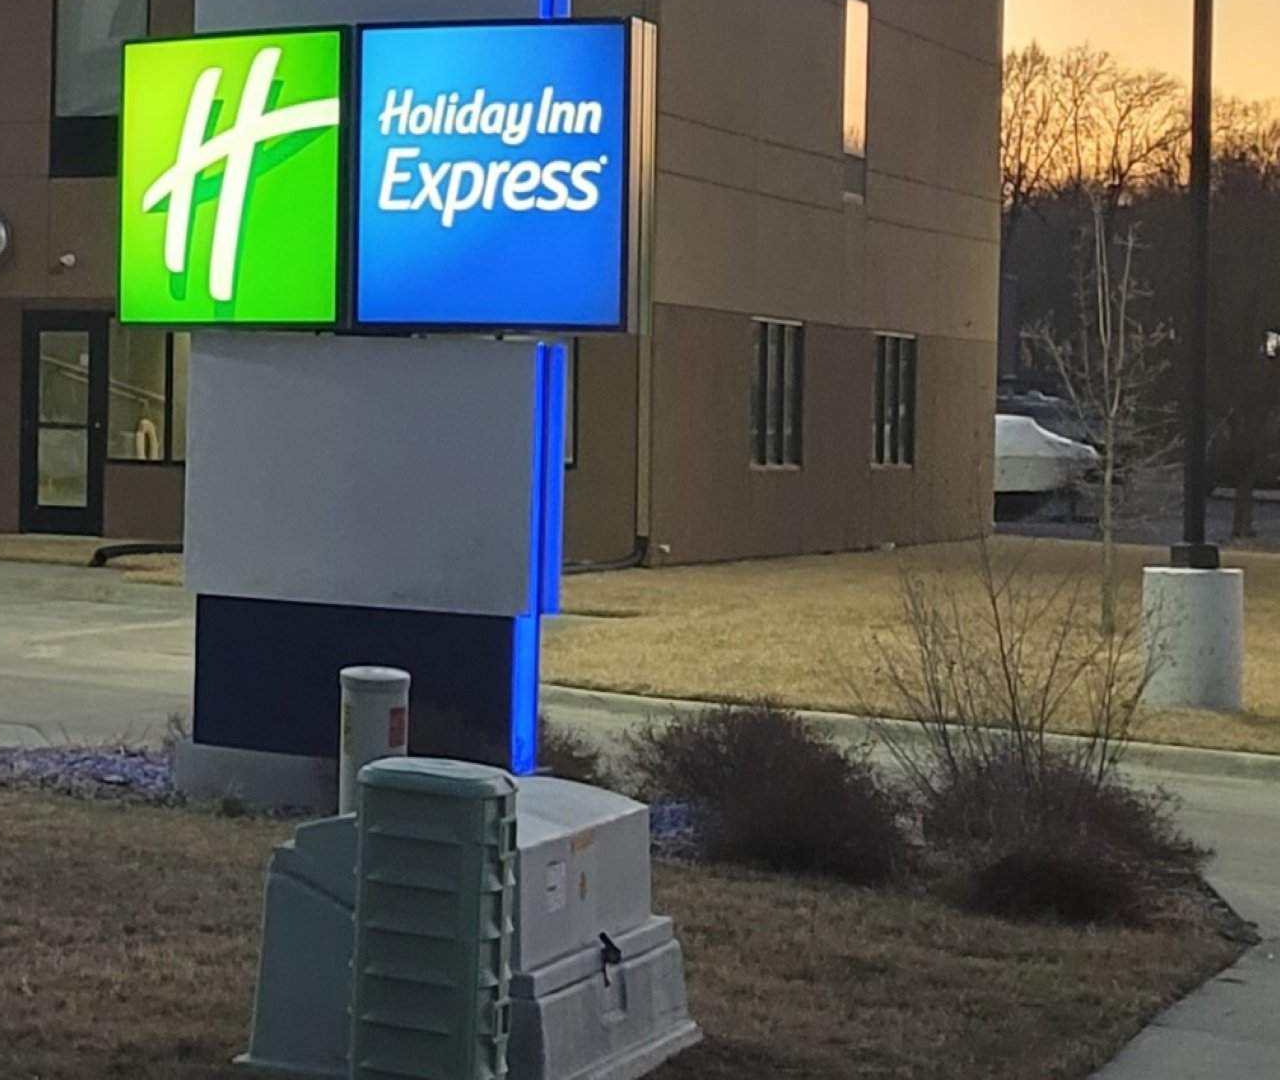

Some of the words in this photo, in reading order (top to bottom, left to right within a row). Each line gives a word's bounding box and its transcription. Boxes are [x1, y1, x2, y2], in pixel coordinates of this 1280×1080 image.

[378, 88, 534, 145] Holiday
[536, 86, 602, 134] Inn
[378, 147, 604, 228] Express
